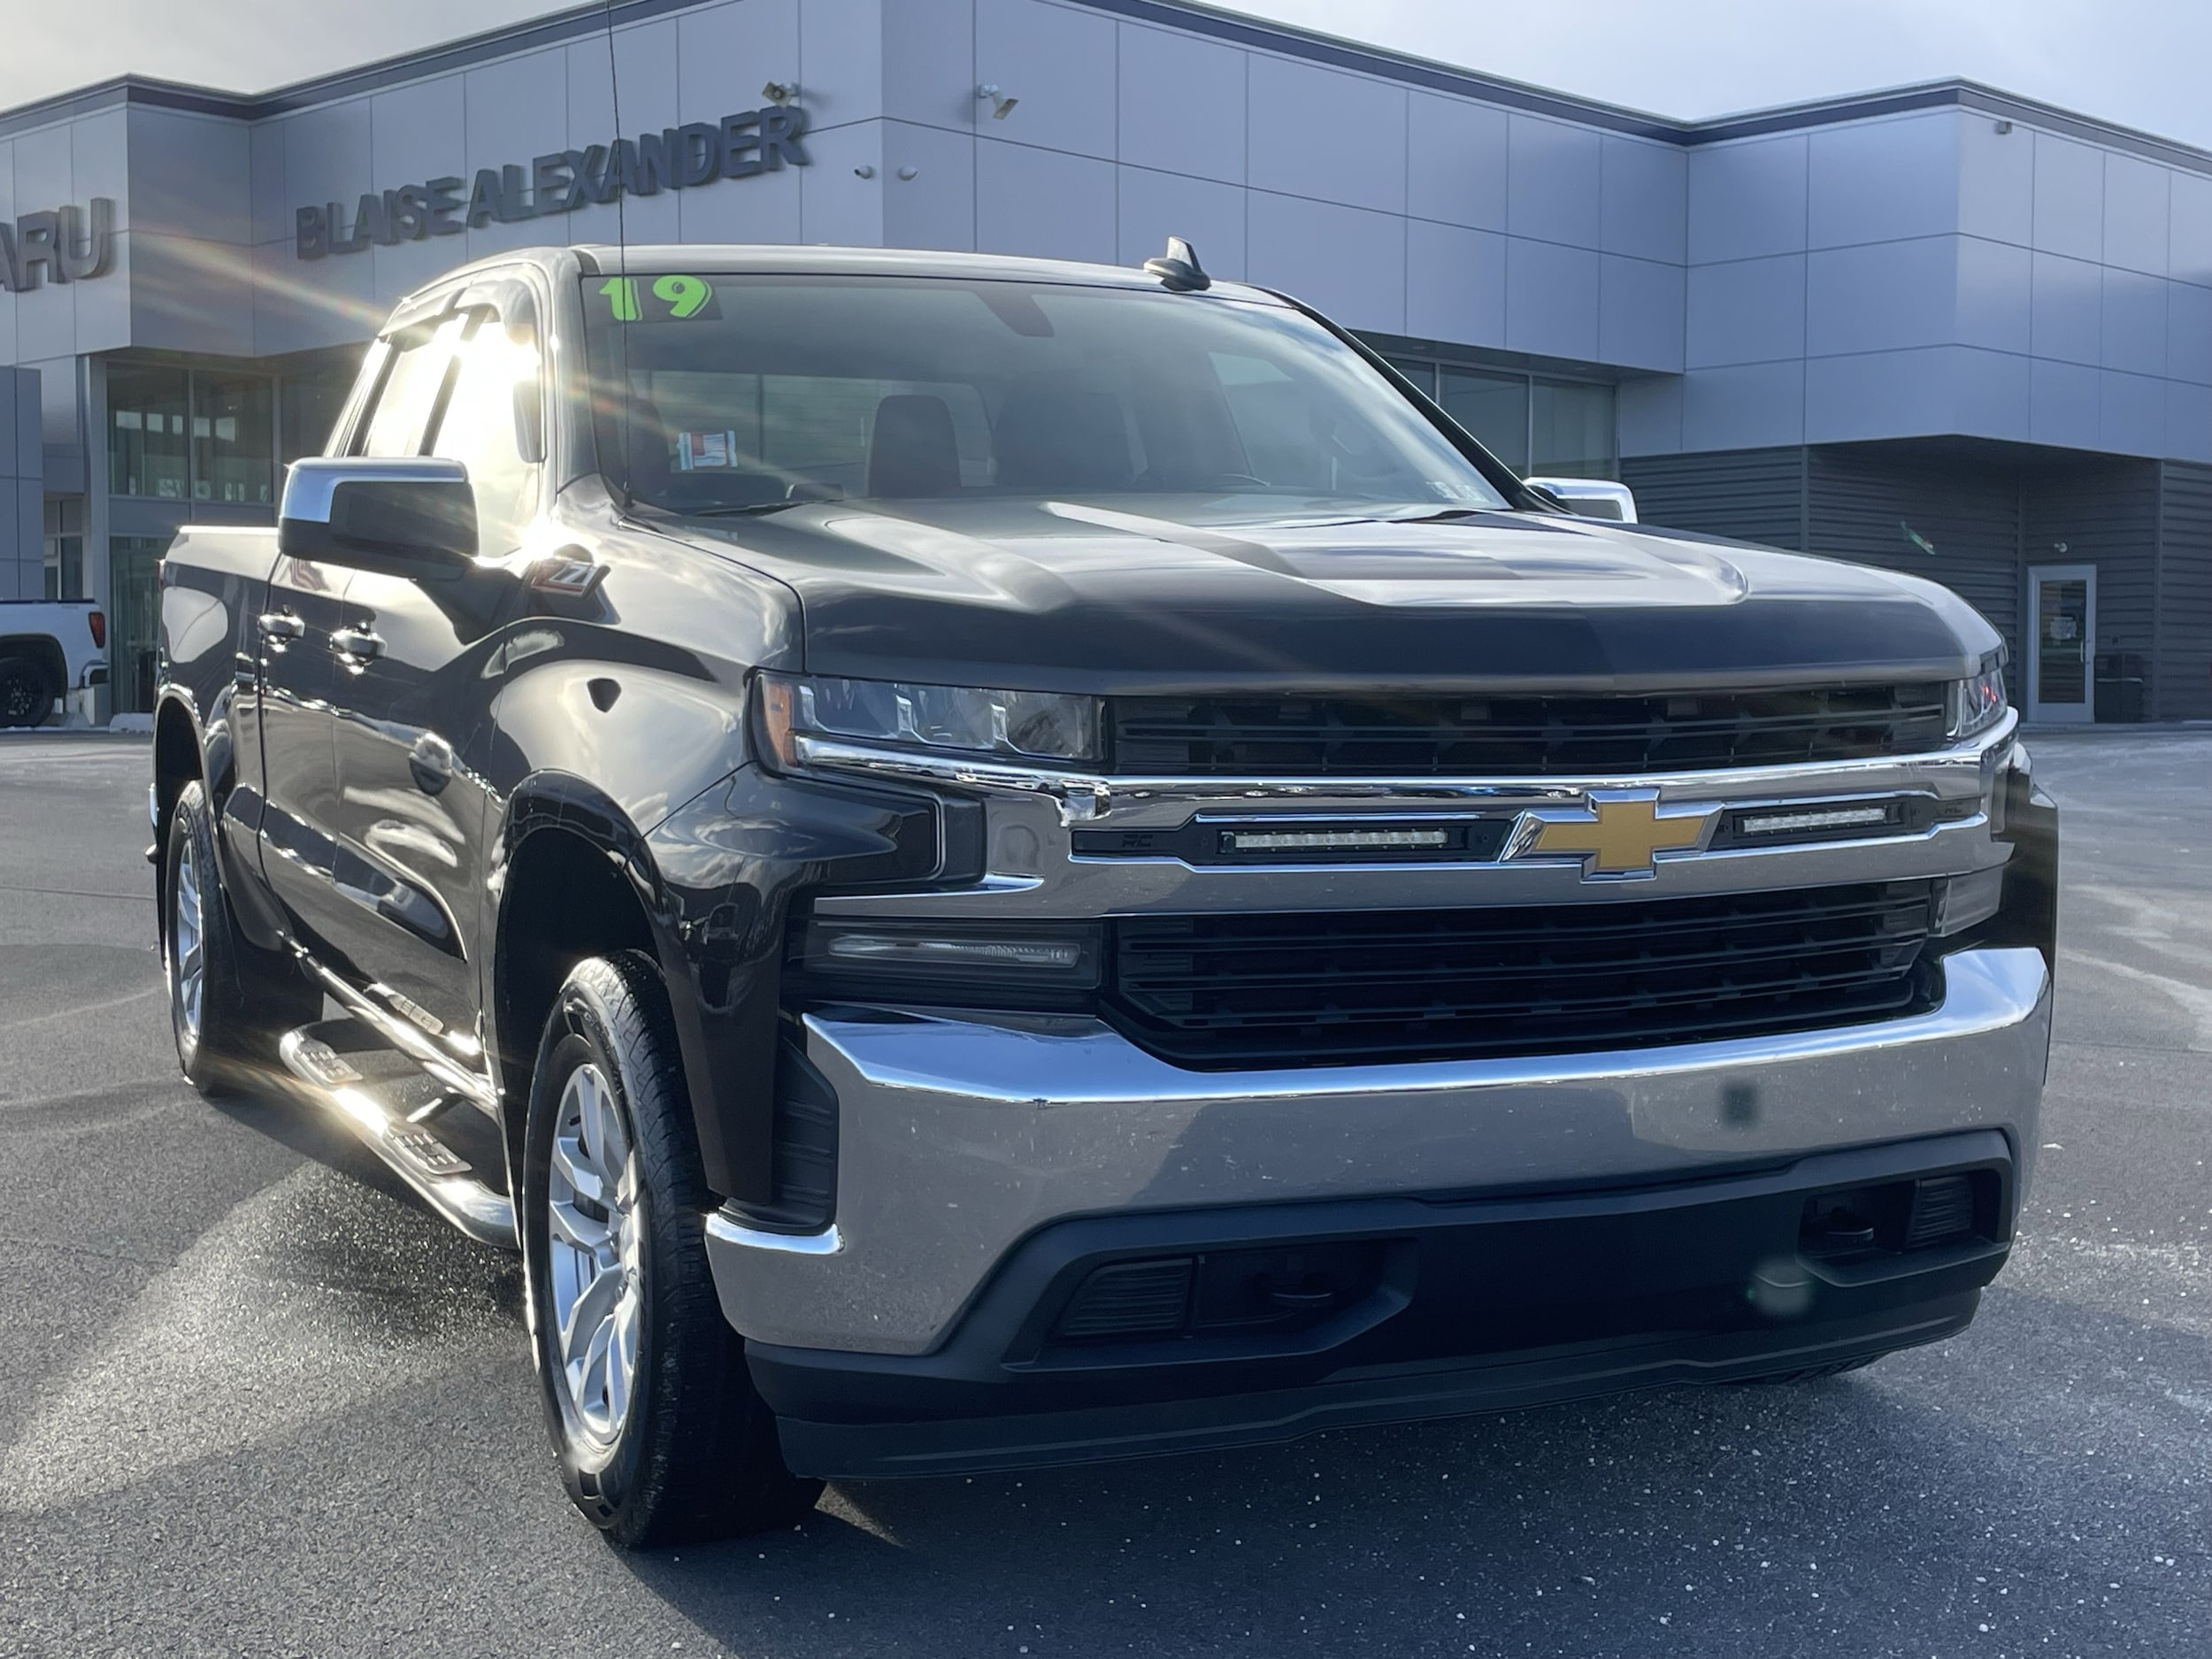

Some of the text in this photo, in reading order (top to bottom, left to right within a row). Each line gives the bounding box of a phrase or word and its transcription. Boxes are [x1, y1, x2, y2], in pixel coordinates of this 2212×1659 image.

[296, 105, 810, 260] BLAISE ALEXANDER
[599, 274, 712, 322] 19
